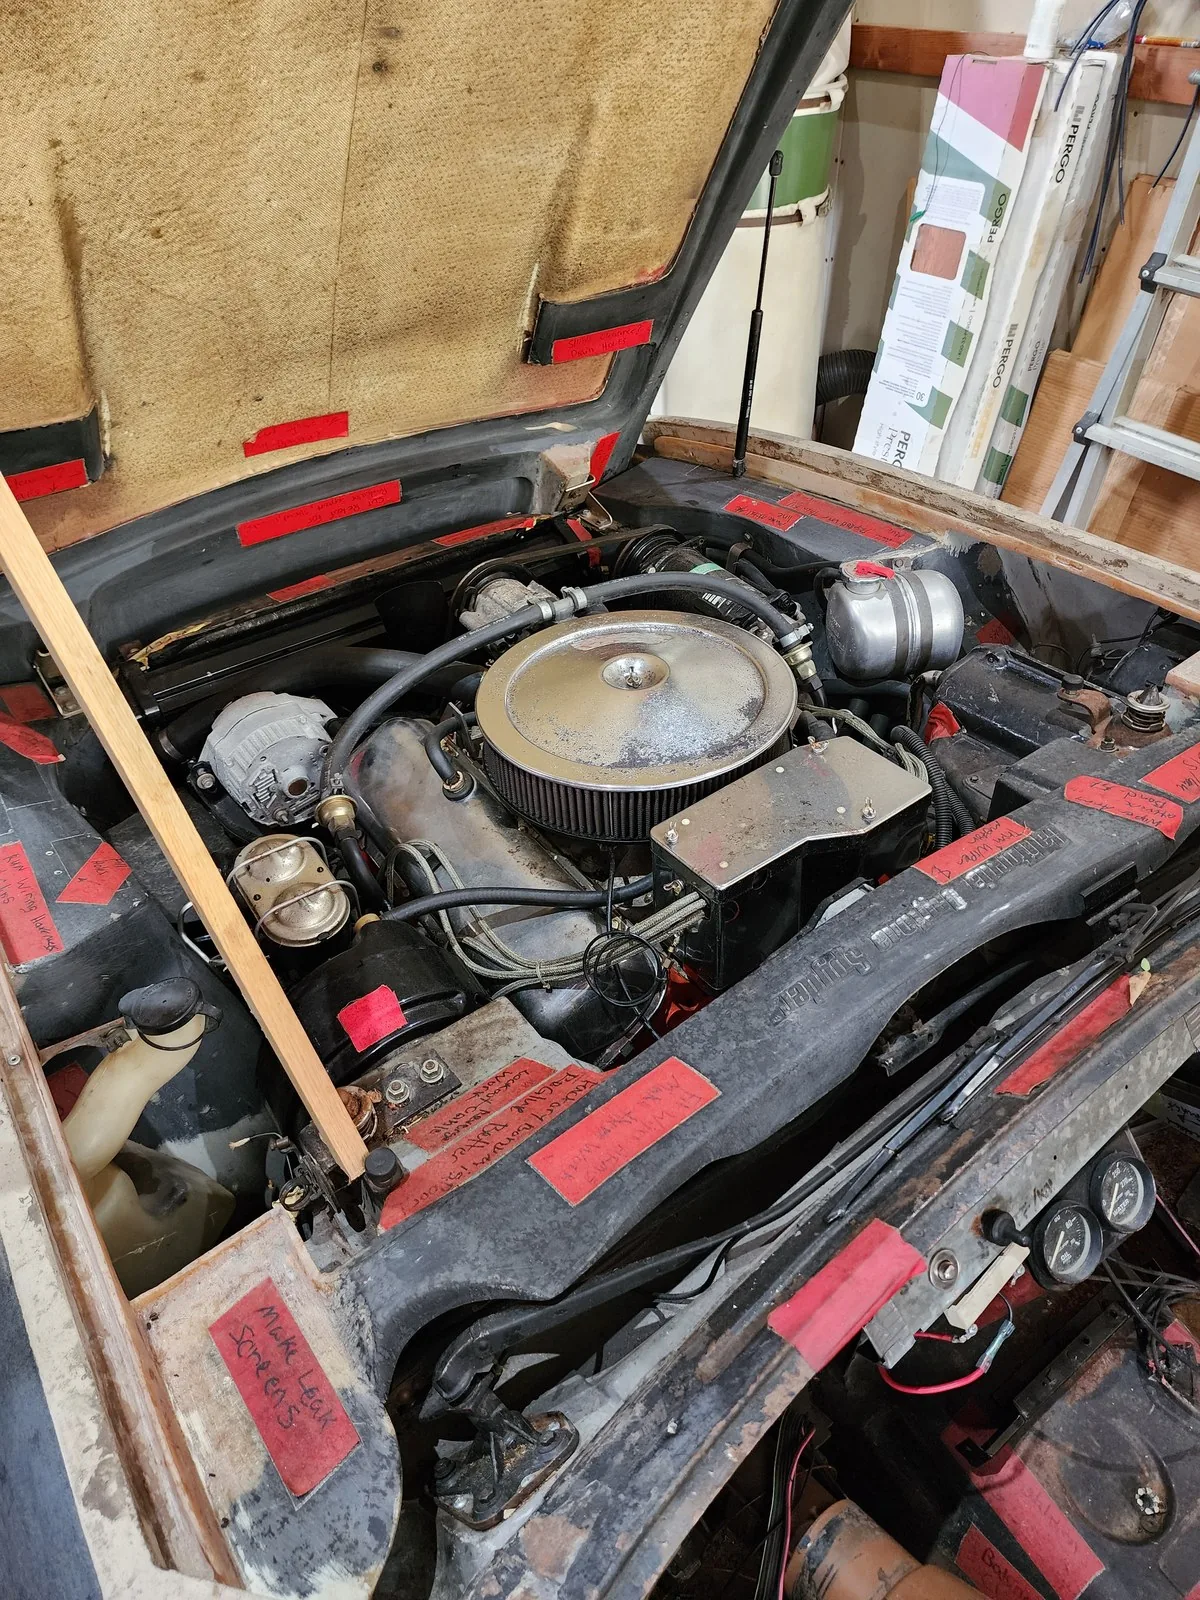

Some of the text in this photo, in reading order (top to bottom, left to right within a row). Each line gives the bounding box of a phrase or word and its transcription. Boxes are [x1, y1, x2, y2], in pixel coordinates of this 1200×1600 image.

[1053, 123, 1080, 184] PERGO
[986, 192, 1008, 243] PERGO
[991, 337, 1013, 389] PERGO
[446, 1121, 508, 1163] Better
[1112, 1198, 1129, 1216] WATER
[1060, 1250, 1070, 1261] OIL
[257, 1305, 337, 1429] Make Leak
